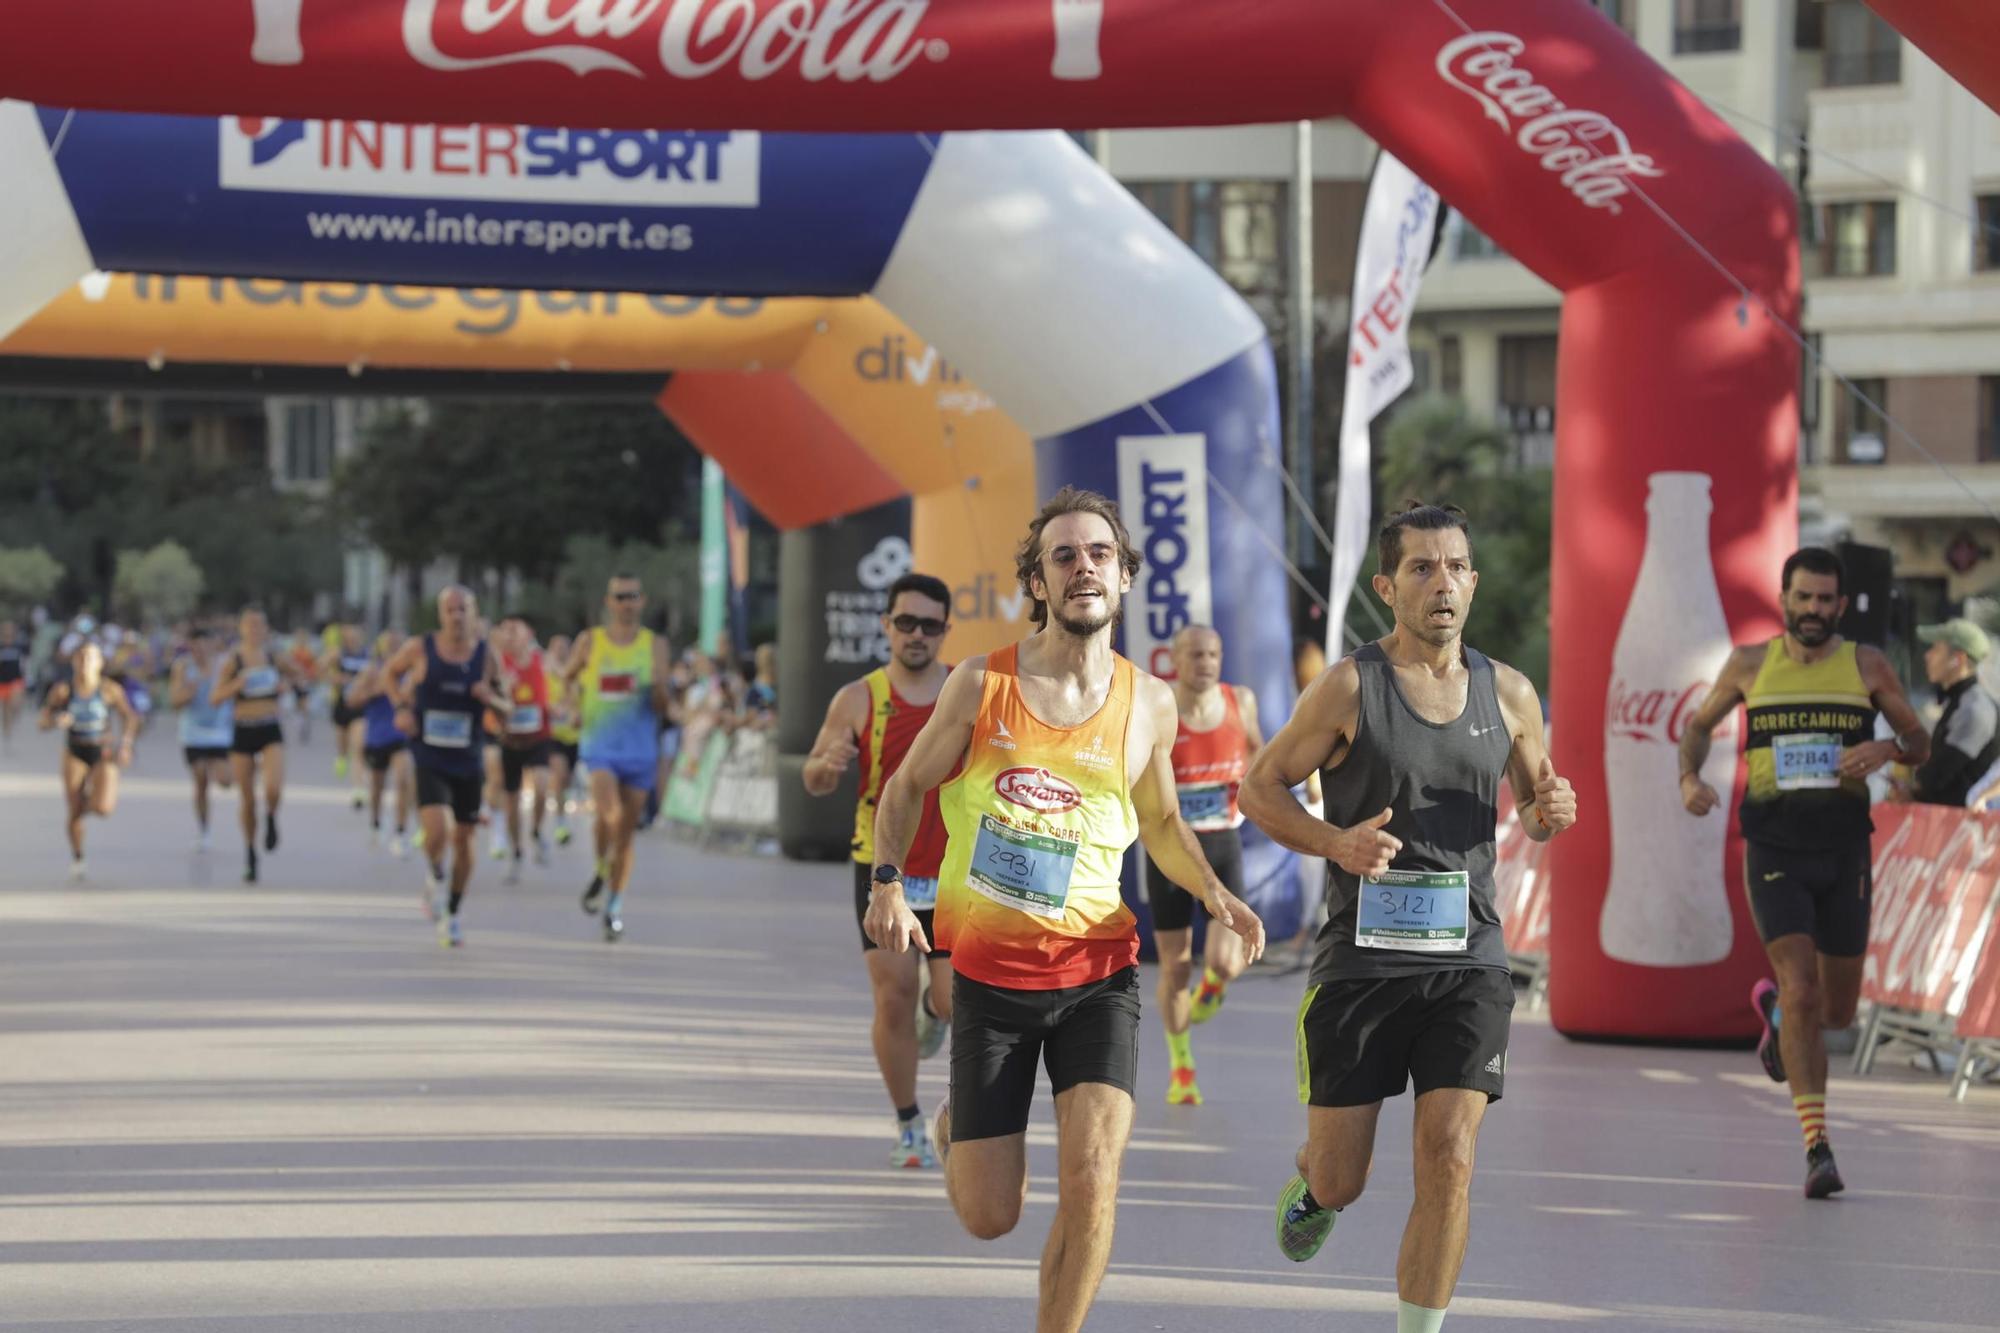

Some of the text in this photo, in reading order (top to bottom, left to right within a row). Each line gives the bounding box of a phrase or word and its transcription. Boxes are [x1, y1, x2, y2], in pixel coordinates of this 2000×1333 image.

[320, 119, 732, 183] INTERSPORT
[307, 208, 693, 252] www.intersport.es
[1002, 775, 1074, 803] Serrano
[1048, 826, 1081, 842] CORRE
[988, 844, 1037, 877] 2931
[1380, 891, 1434, 915] 3121
